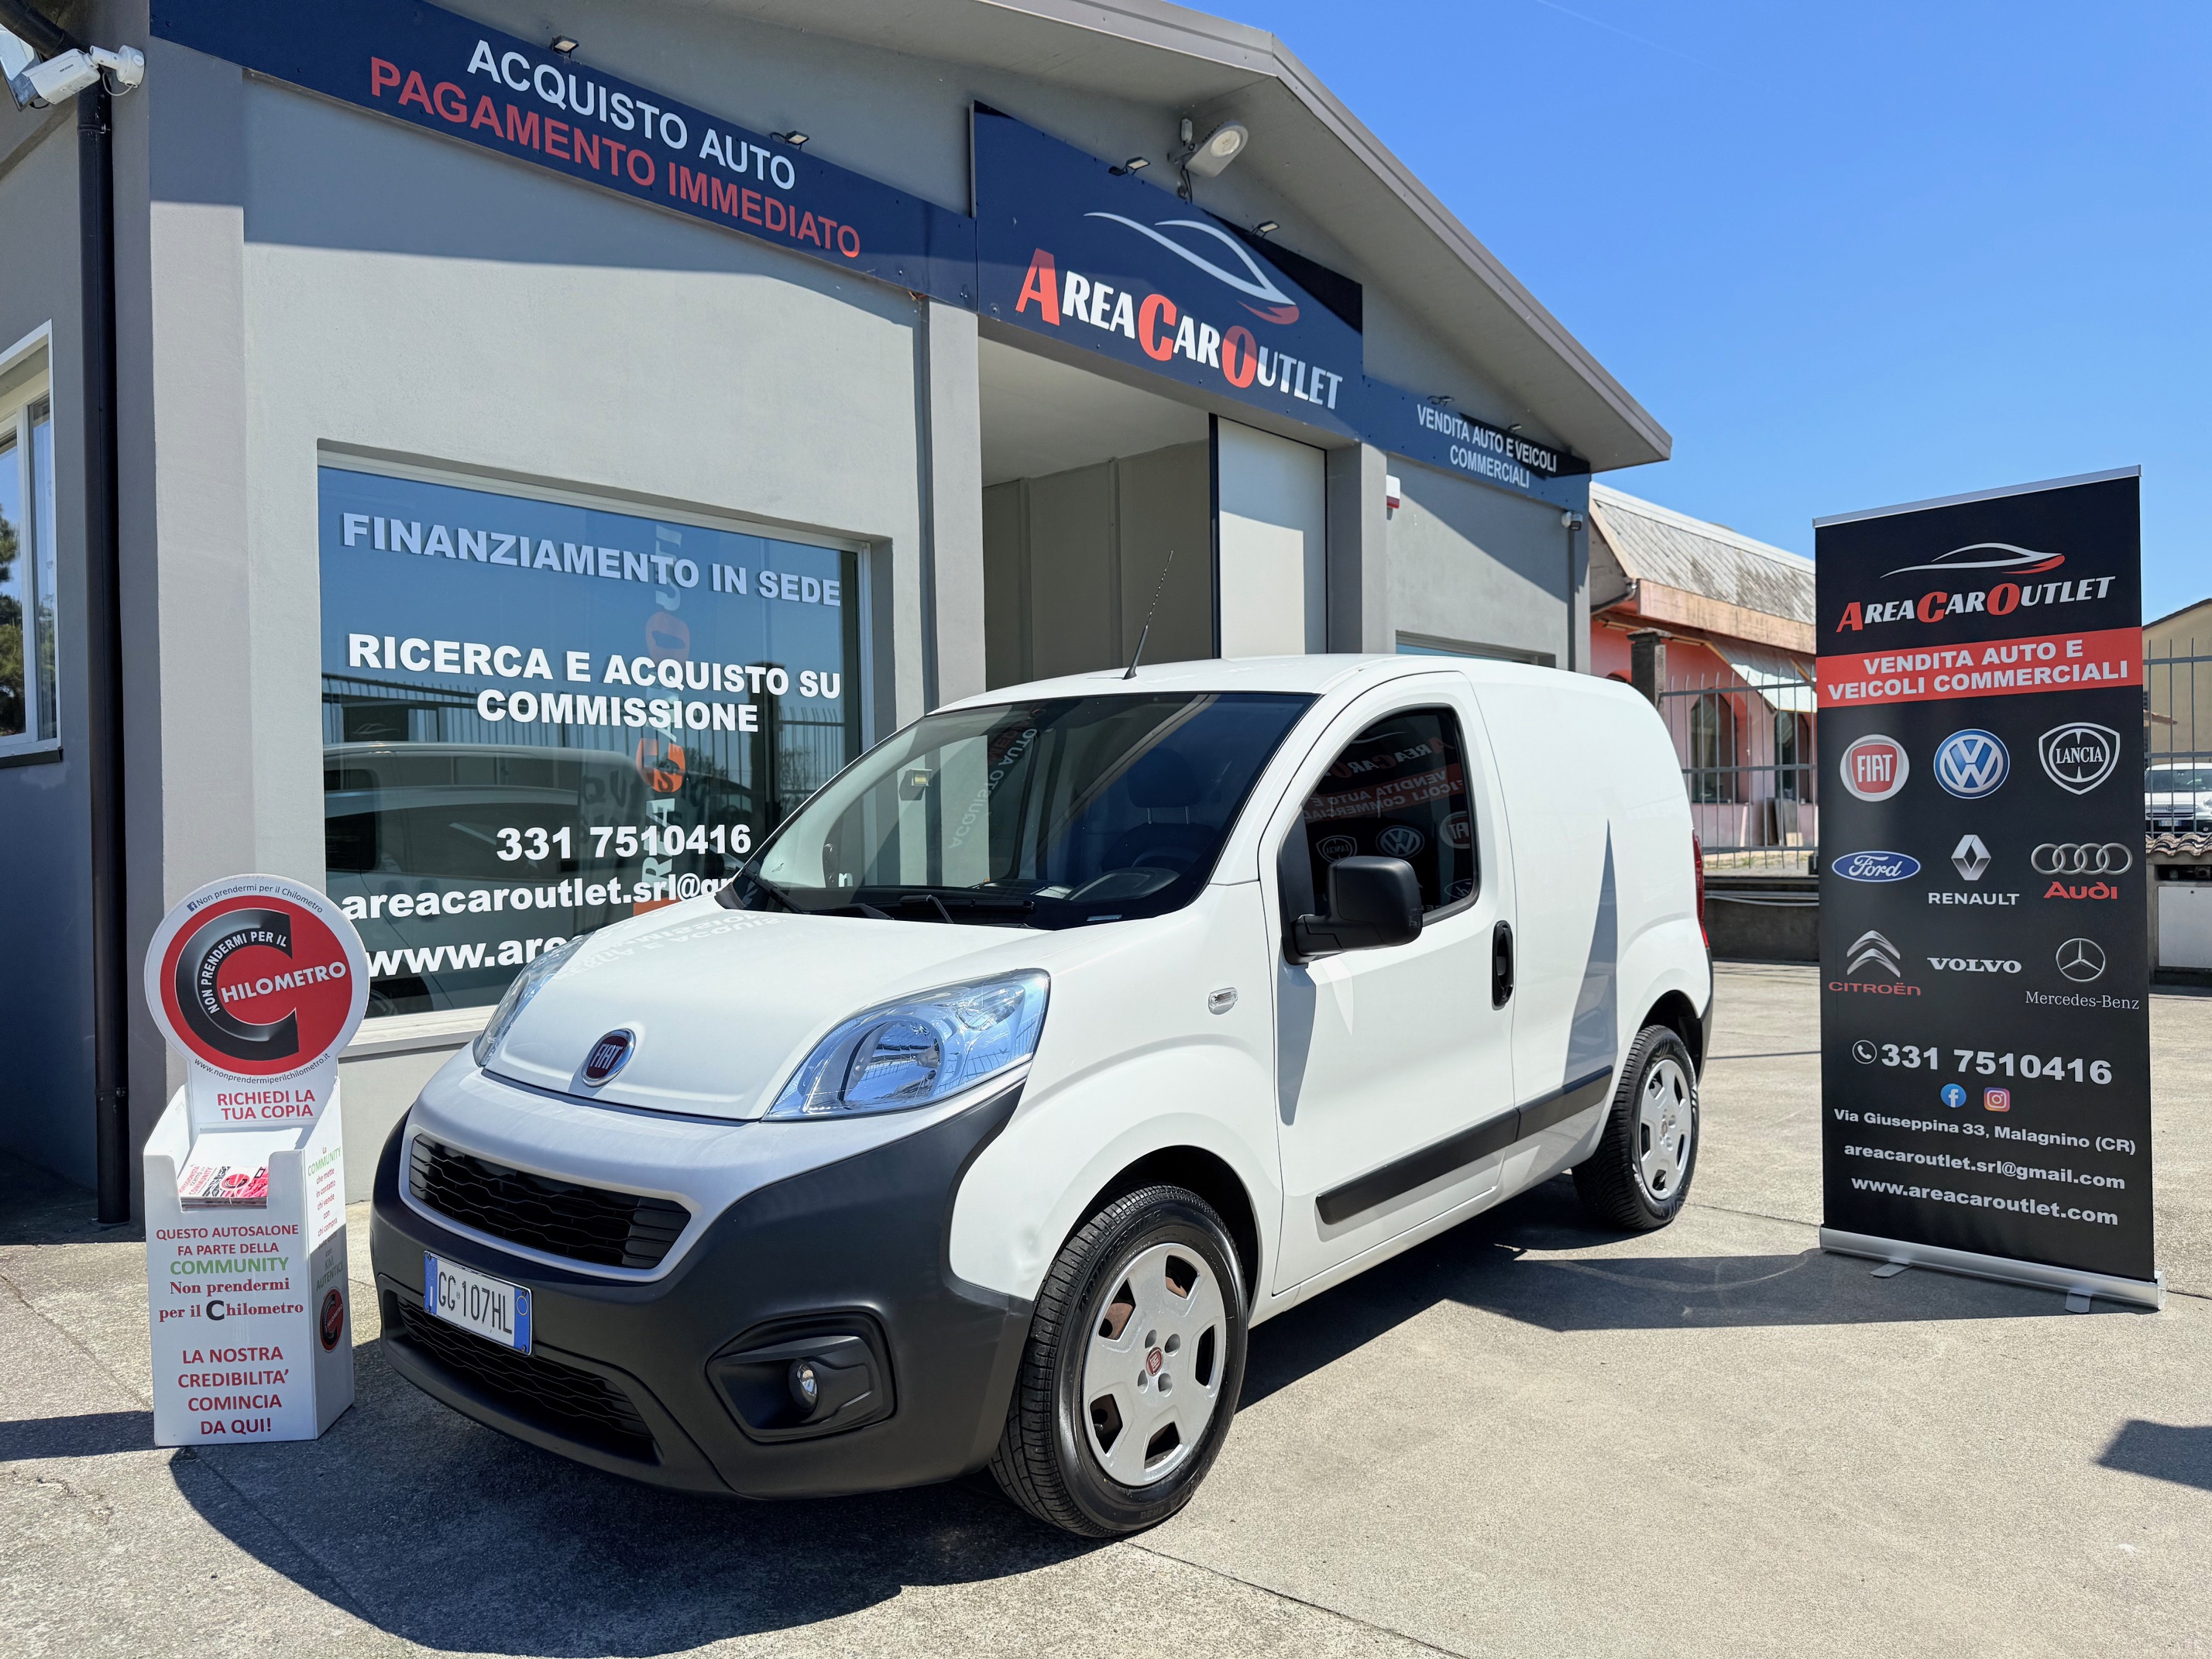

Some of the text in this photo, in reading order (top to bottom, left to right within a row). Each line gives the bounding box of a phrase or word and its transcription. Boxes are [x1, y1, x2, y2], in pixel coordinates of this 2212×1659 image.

[467, 40, 795, 190] ACQUISTO AUTO
[370, 57, 860, 258] PAGAMENTO IMMEDIATO
[1417, 404, 1557, 472] VENDITA AUTO E VEICOLI
[1450, 445, 1530, 489] COMMERCIALI
[343, 512, 840, 607] FINANZIAMENTO IN SEDE
[349, 633, 840, 699] RICERCA E ACQUISTO SU
[1863, 640, 2083, 675] VENDITA AUTO E
[1828, 660, 2128, 700] VEICOLI COMMERCIALI
[477, 689, 758, 732] COMMISSIONE
[2055, 746, 2104, 764] LANCIA
[1857, 754, 1893, 783] FIAT
[496, 824, 751, 861] 331 7510416
[1848, 854, 1901, 878] Ford
[197, 893, 214, 907] Non
[214, 884, 257, 900] prendermi
[259, 884, 273, 894] per
[282, 888, 323, 914] Chilometro
[1928, 891, 2020, 906] RENAULT
[2043, 881, 2118, 900] Audi
[201, 931, 287, 1015] NON PRENDERMI PER IL
[1927, 957, 2021, 974] VOLVO
[1829, 981, 1921, 997] CITROËN
[2025, 991, 2140, 1010] Mercedes-Benz
[589, 1043, 624, 1070] FIAT
[1881, 1042, 2112, 1085] 331 7510416
[217, 1089, 316, 1106] RICHIEDI LA
[221, 1104, 314, 1121] TUA COPIA
[1834, 1108, 2136, 1156] Via Giuseppina 33, Malagnino (CR)
[307, 1146, 341, 1176] COMMUNITY
[1844, 1143, 2125, 1190] areacaroutlet.srl@gmail.com
[189, 1166, 213, 1195] COMMUNITY
[323, 1168, 335, 1180] mette
[320, 1180, 336, 1195] contatto
[323, 1194, 335, 1205] vende
[1851, 1177, 2118, 1225] www.areacaroutlet.com
[156, 1224, 299, 1241] QUESTO AUTOSALONE
[324, 1218, 338, 1232] compra
[177, 1242, 279, 1256] FA PARTE DELLA
[170, 1256, 290, 1276] COMMUNITY
[316, 1259, 343, 1292] AUTENTICI
[170, 1277, 290, 1297] Non prendermi
[159, 1307, 185, 1323] per
[191, 1304, 202, 1317] il
[206, 1300, 304, 1321] Chilometro
[182, 1346, 284, 1364] LA NOSTRA
[177, 1369, 289, 1388] CREDIBILITA'
[187, 1394, 282, 1412] COMINCIA
[201, 1417, 272, 1436] DA QUI!
